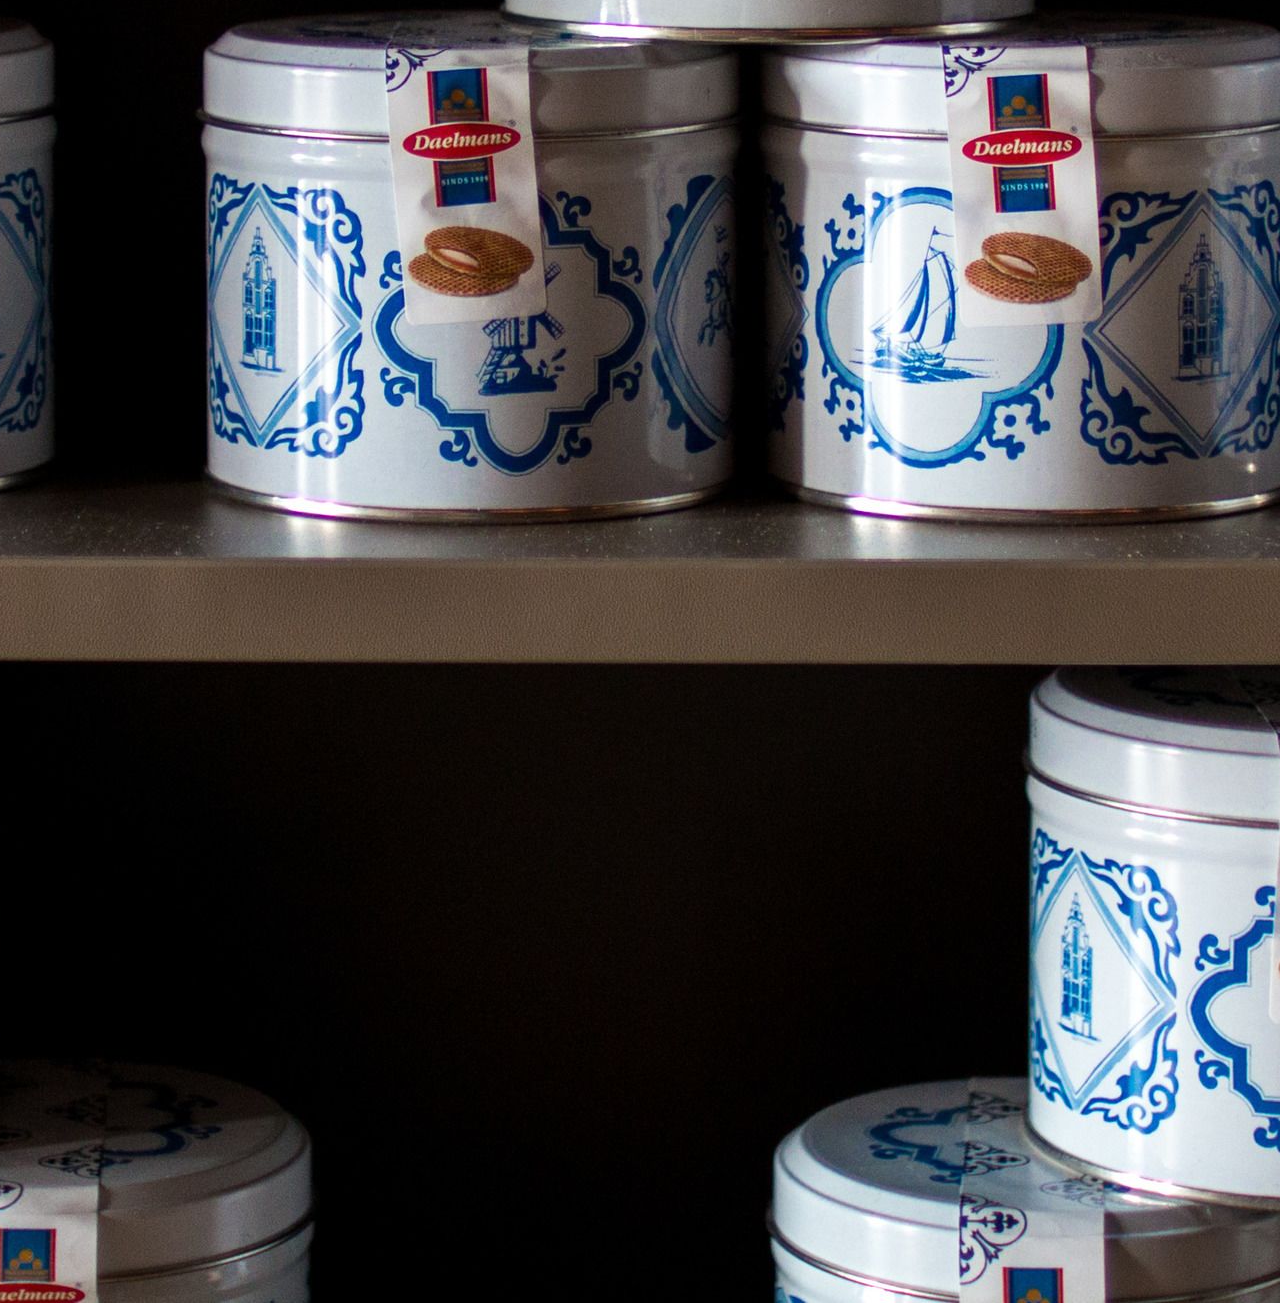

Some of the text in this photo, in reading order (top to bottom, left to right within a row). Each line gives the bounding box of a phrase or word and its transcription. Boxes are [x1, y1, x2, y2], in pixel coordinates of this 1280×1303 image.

[414, 132, 510, 150] Daelmans
[973, 139, 1073, 156] Daelmans
[441, 177, 468, 186] SINDS
[1001, 182, 1028, 192] SINDS
